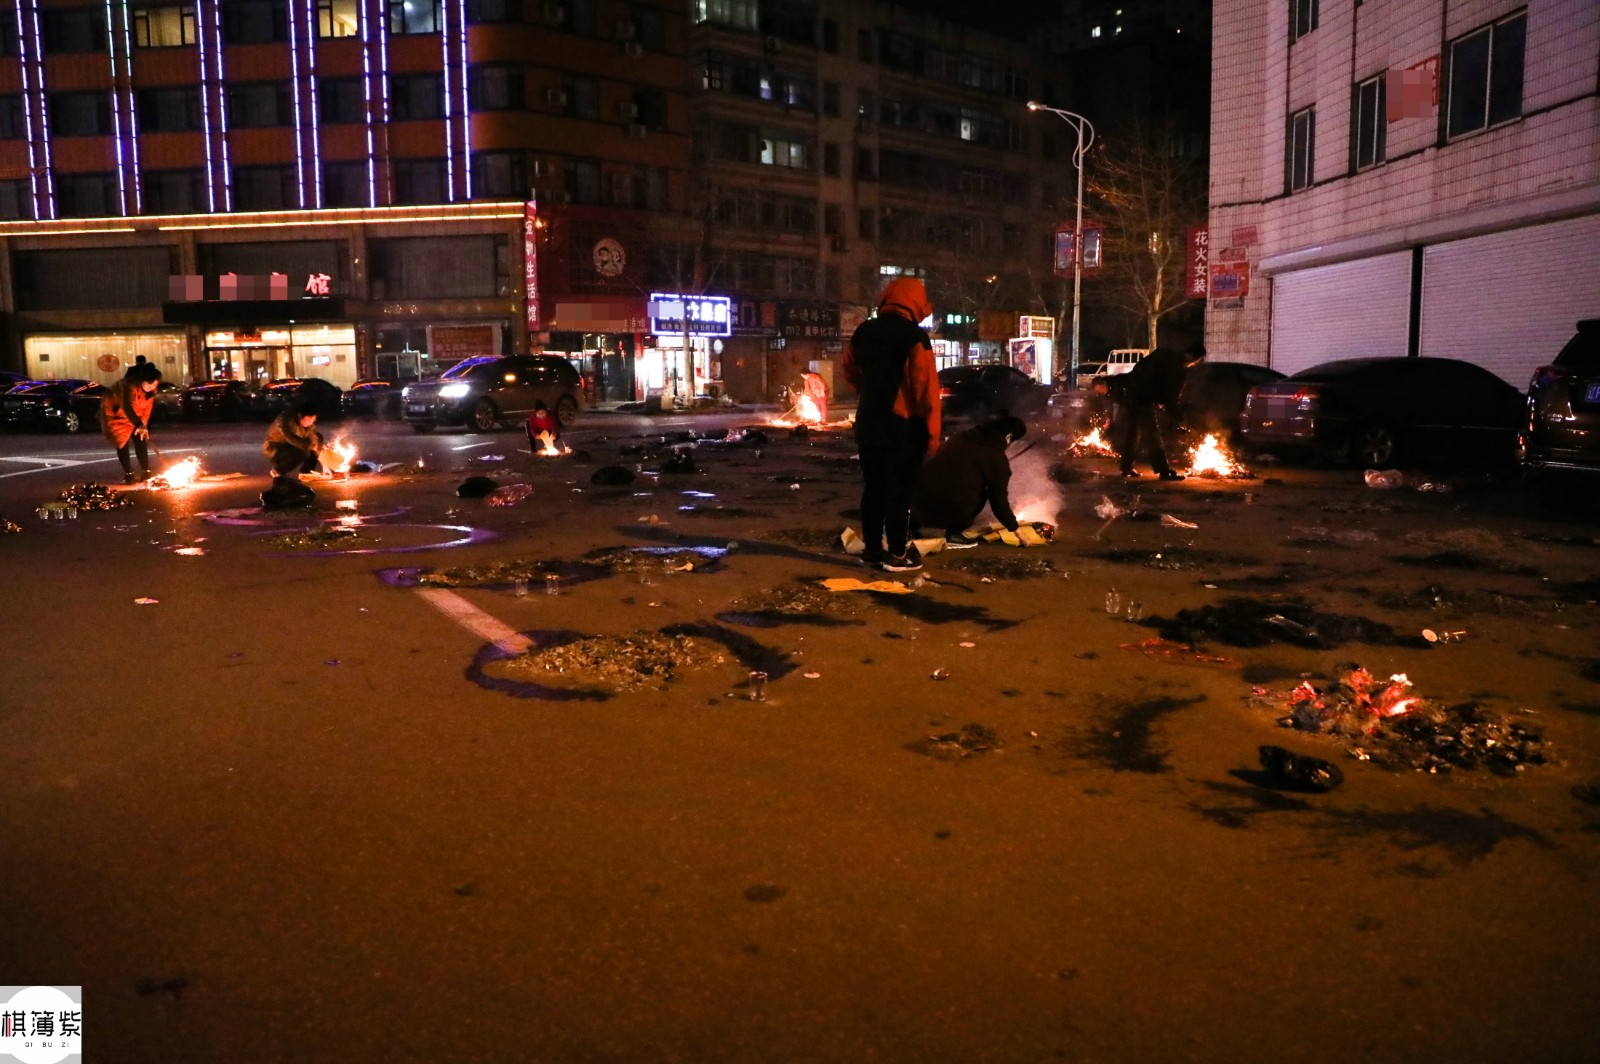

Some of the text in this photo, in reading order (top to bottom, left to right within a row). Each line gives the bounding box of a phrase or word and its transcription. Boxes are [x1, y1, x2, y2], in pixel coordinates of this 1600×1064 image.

[525, 217, 537, 322] 宠物生活馆
[1193, 230, 1208, 293] 花火女装
